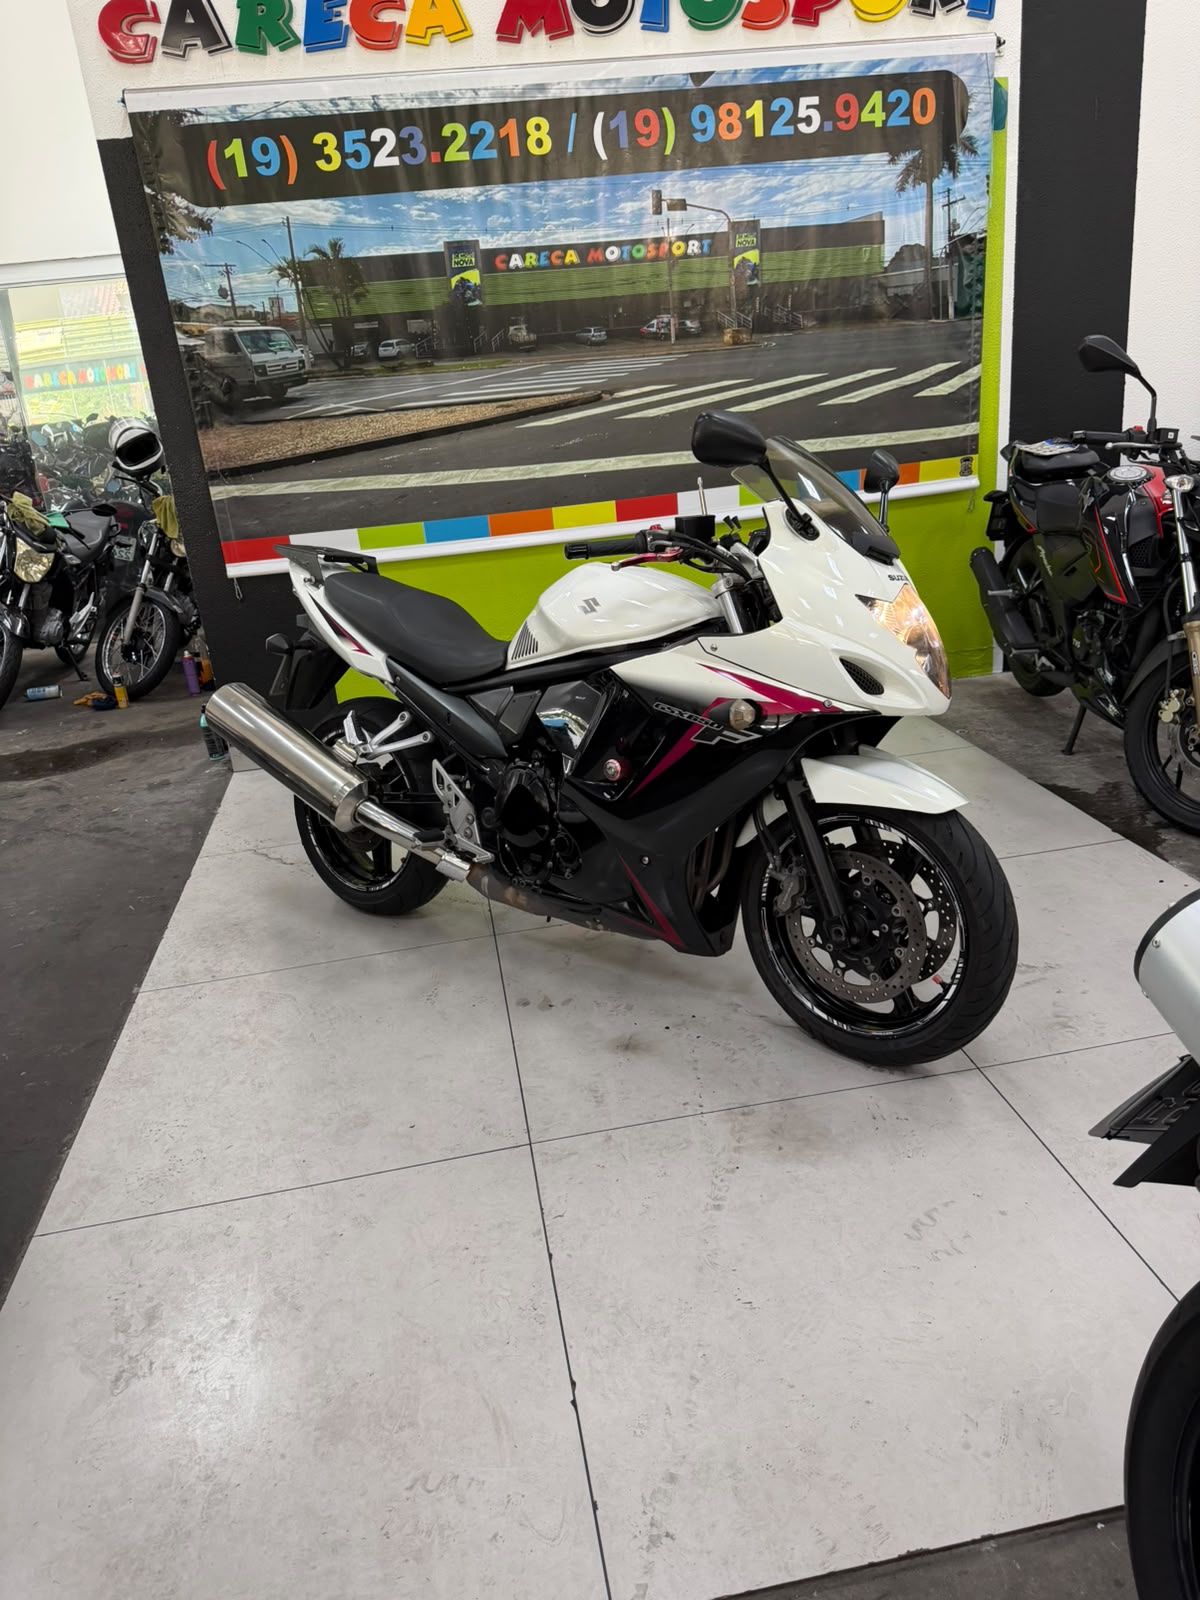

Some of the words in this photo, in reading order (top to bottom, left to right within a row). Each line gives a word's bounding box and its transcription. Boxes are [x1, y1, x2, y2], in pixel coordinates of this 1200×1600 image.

[98, 0, 473, 64] CARECA
[207, 135, 298, 190] (19)
[312, 116, 552, 172] 3523.2218
[567, 113, 577, 153] /
[593, 107, 676, 160] (19)
[690, 87, 937, 142] 98125.9420
[494, 250, 580, 270] CARECA
[587, 239, 712, 263] MOTOSPORT
